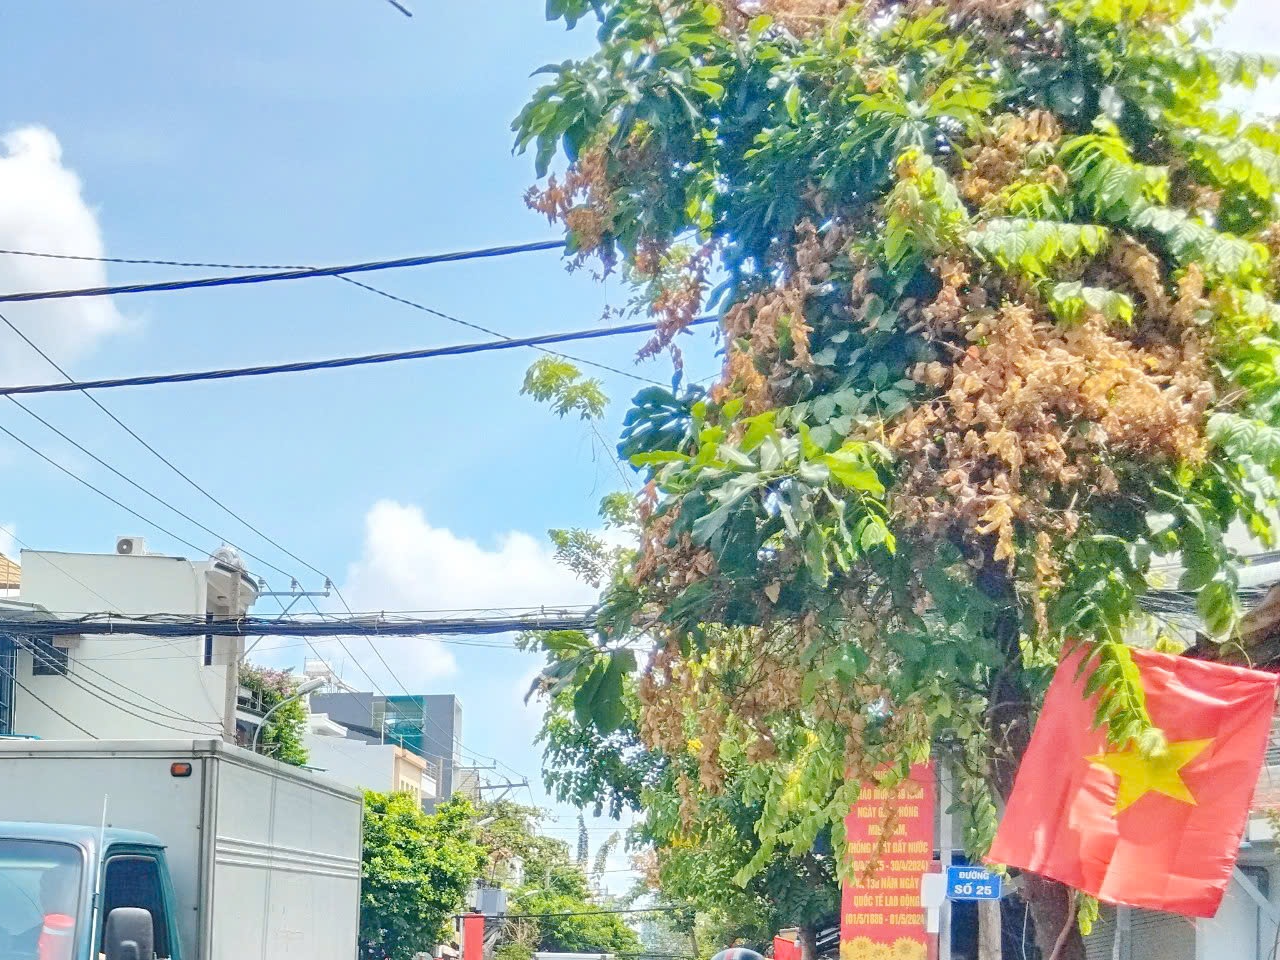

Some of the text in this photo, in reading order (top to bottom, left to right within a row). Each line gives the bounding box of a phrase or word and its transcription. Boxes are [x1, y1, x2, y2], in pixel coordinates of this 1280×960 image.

[894, 803, 919, 818] HÓNG
[958, 870, 990, 880] ĐƯỜNG
[954, 882, 992, 895] SỐ 25
